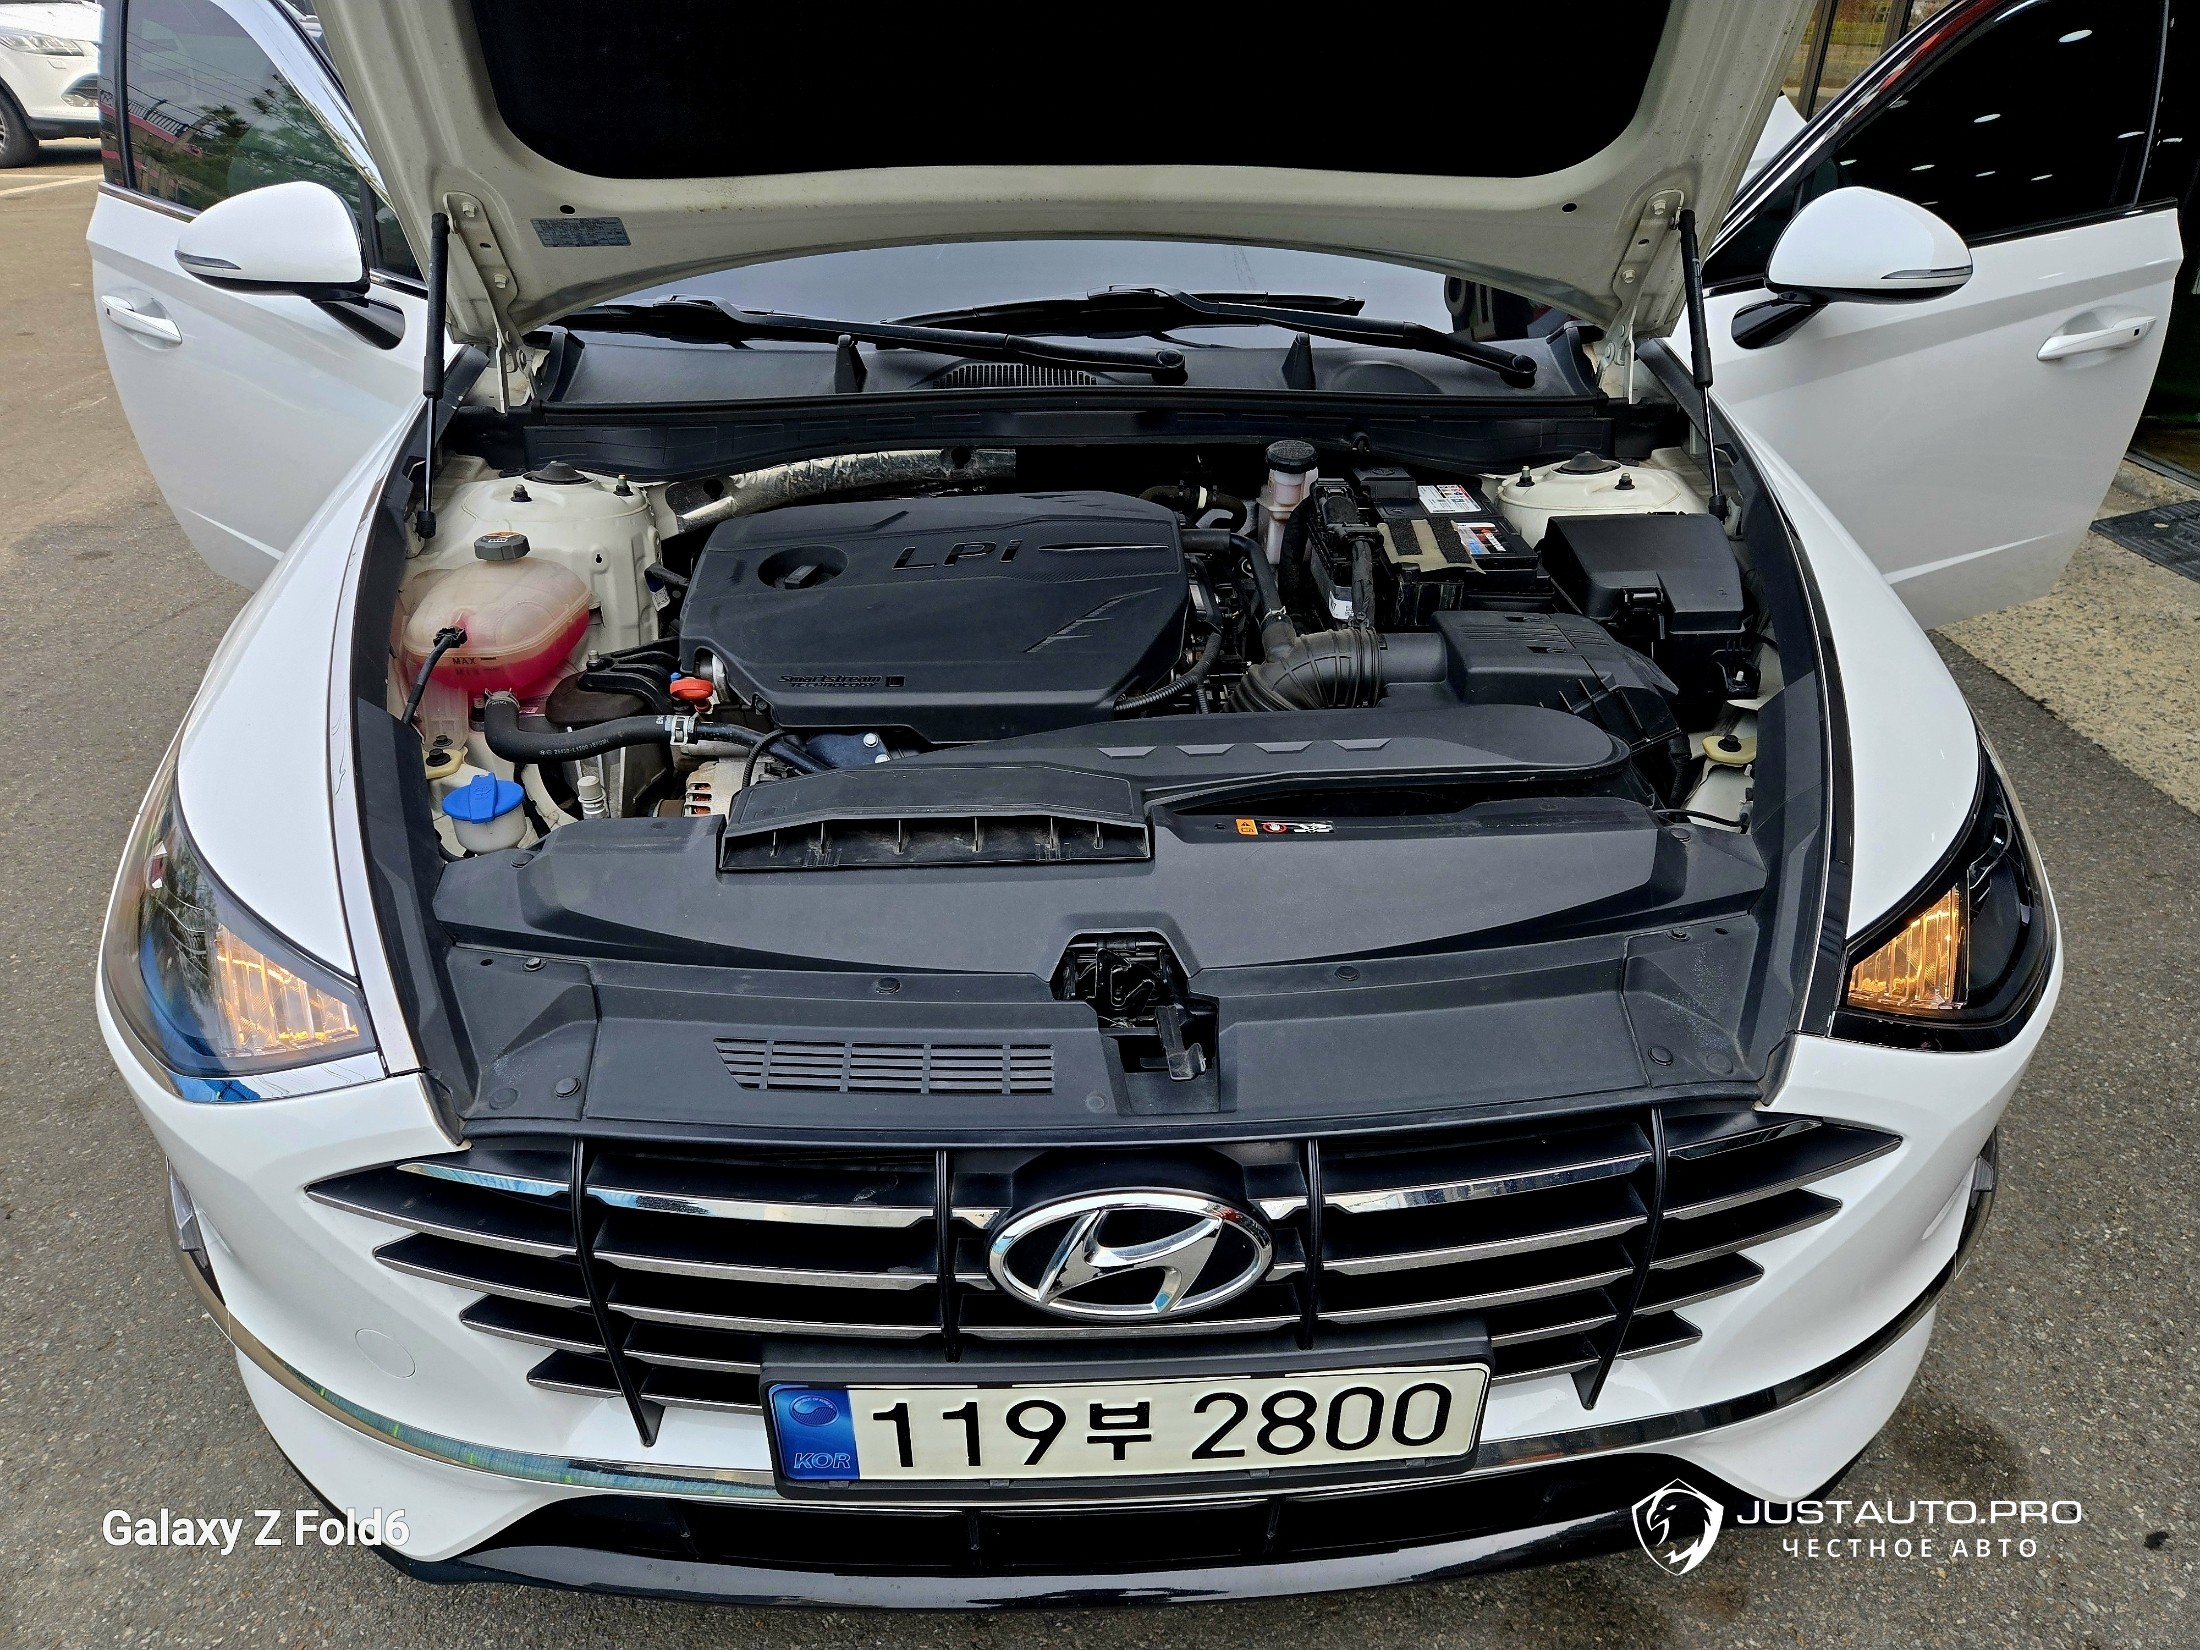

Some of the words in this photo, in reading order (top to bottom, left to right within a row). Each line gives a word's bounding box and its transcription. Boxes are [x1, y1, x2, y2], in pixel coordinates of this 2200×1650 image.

[452, 656, 477, 665] MAX
[778, 675, 882, 683] Smartstream
[873, 1398, 1152, 1468] 119부
[1192, 1382, 1454, 1461] 2800
[794, 1452, 851, 1469] KOR
